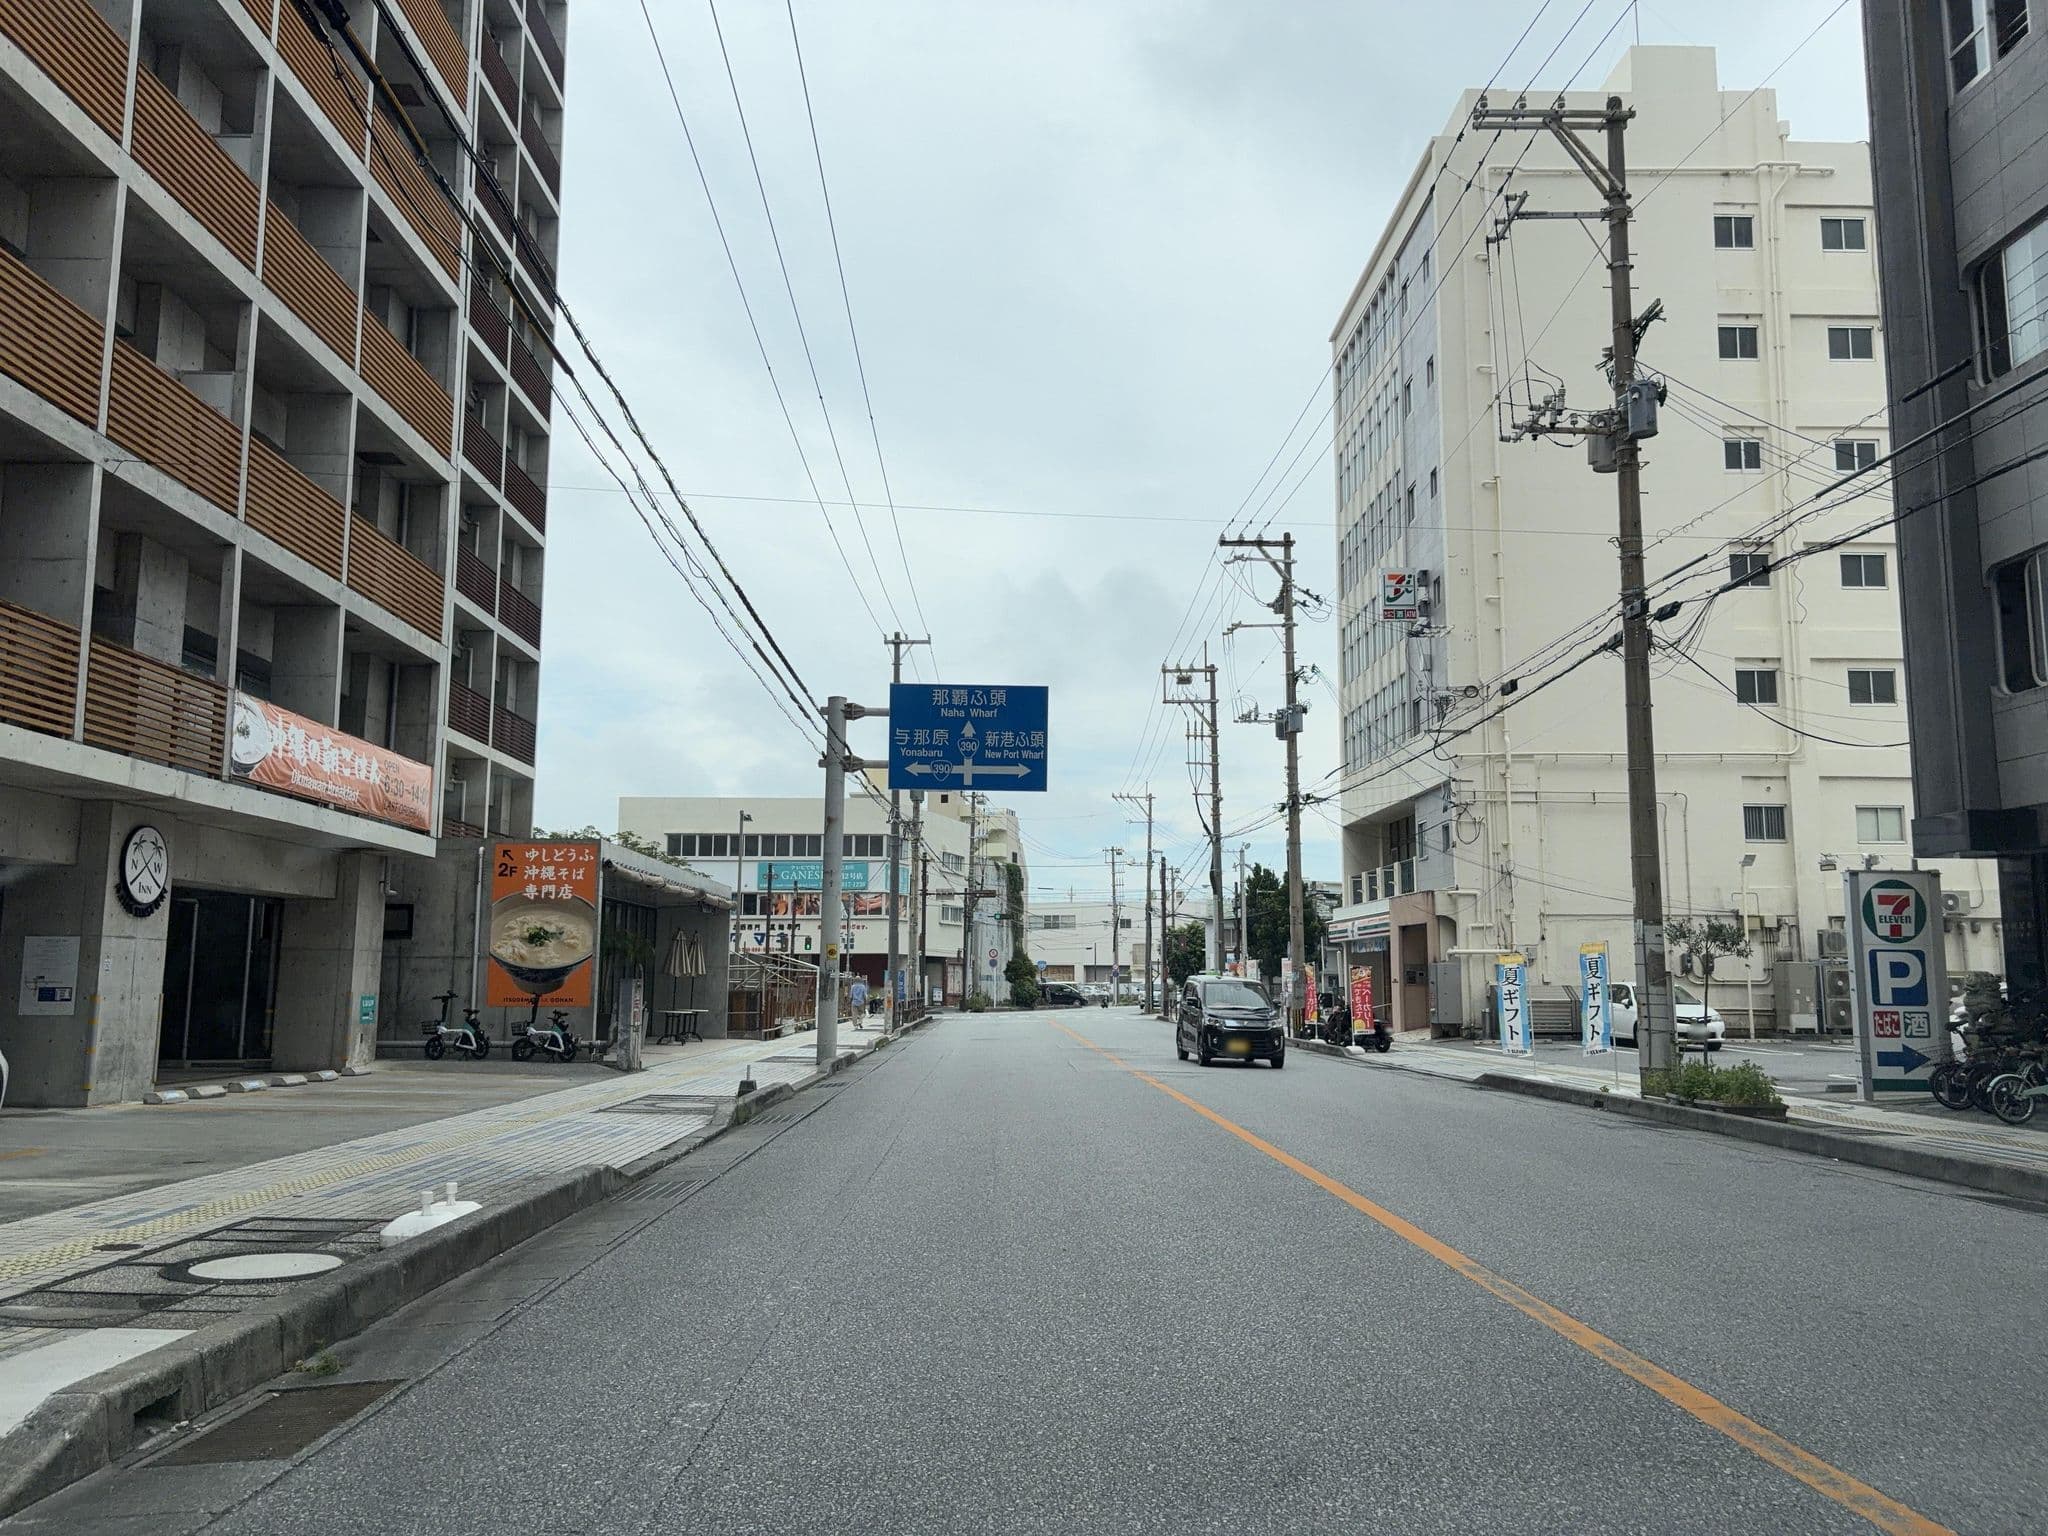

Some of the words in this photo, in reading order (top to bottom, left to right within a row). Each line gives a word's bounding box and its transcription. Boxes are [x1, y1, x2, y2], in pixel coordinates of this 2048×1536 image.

[932, 689, 1007, 707] 那覇ふ頭
[941, 708, 965, 718] Naha
[970, 708, 998, 718] Wharf
[894, 728, 949, 746] 与那原
[984, 731, 1045, 748] 新港ふ頭
[900, 747, 943, 758] Yonabaru
[959, 742, 977, 752] 390
[985, 750, 1002, 759] New
[1003, 750, 1020, 759] Port
[1021, 750, 1044, 759] Wharf
[933, 763, 950, 774] 390
[525, 848, 594, 862] ゆしどうふ
[131, 859, 139, 871] N
[154, 861, 163, 874] W
[498, 863, 518, 877] 2F
[523, 866, 585, 881] 沖縄そば
[523, 883, 575, 900] 専門店
[1876, 951, 1923, 1005] P
[1502, 967, 1521, 1041] 夏ギフト
[1586, 957, 1603, 1041] 夏ギフト
[1874, 1012, 1900, 1036] たばこ
[1904, 1012, 1929, 1037] 酒
